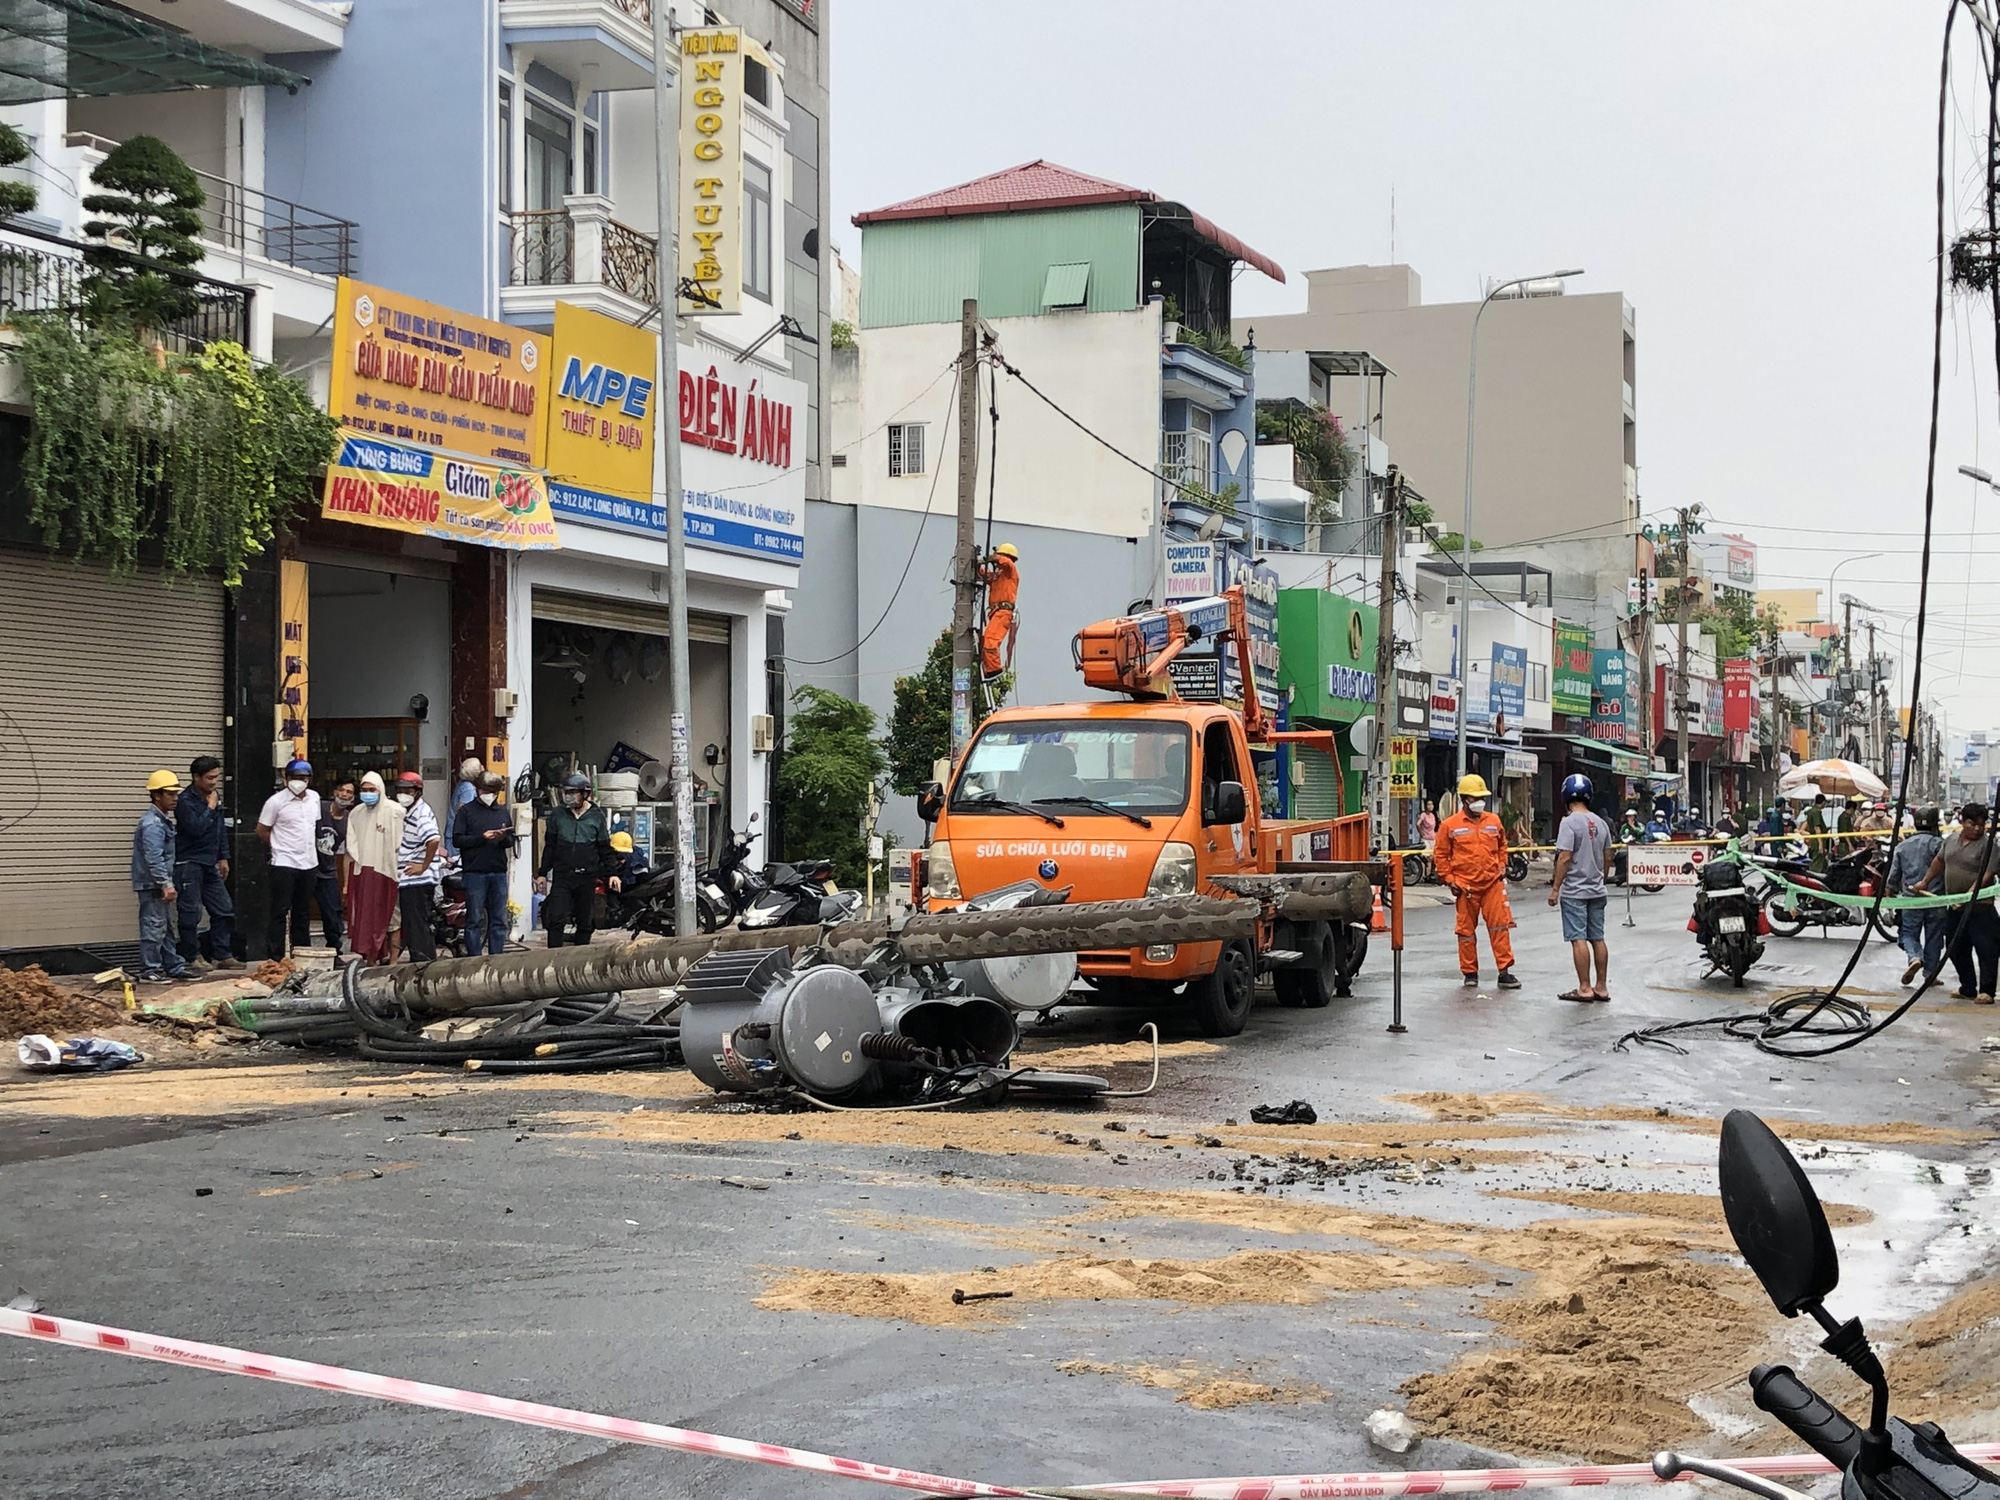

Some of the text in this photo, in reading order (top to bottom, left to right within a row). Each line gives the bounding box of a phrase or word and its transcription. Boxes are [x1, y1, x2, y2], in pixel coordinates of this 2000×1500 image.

[683, 31, 737, 58] TIỆM VÀNG
[693, 61, 724, 161] NGỌC
[355, 331, 382, 379] CỬA
[384, 344, 419, 388] HÀNG
[450, 355, 475, 401] SẢN
[476, 362, 510, 408] PHẨM
[511, 381, 535, 415] ONG
[558, 355, 654, 420] MPE
[562, 409, 643, 452] THIẾT BỊ ĐIỆN
[739, 378, 793, 469] ÁNH
[444, 460, 491, 500] Giảm
[328, 476, 441, 524] KHAI TRƯƠNG
[563, 489, 577, 508] 912
[578, 494, 592, 512] LẠC
[593, 498, 612, 515] LONG
[613, 502, 634, 521] QUÂN,
[635, 507, 649, 525] P.8,
[714, 494, 728, 513] DÂN
[729, 499, 748, 518] DỤNG
[755, 504, 772, 522] CÔNG
[772, 509, 796, 529] NGHIỆP
[528, 521, 554, 536] ONG
[780, 537, 791, 552] 744
[1167, 547, 1211, 559] COMPUTER
[1171, 561, 1206, 573] CAMERA
[1168, 578, 1197, 594] TRỌNG
[1175, 663, 1216, 673] Vantech
[1607, 655, 1623, 670] CỬA
[1601, 671, 1623, 685] HÀNG
[976, 841, 1004, 858] SỬA
[1008, 840, 1048, 856] CHỮA
[1091, 843, 1128, 860] ĐIỆN
[1631, 862, 1660, 875] CÔNG
